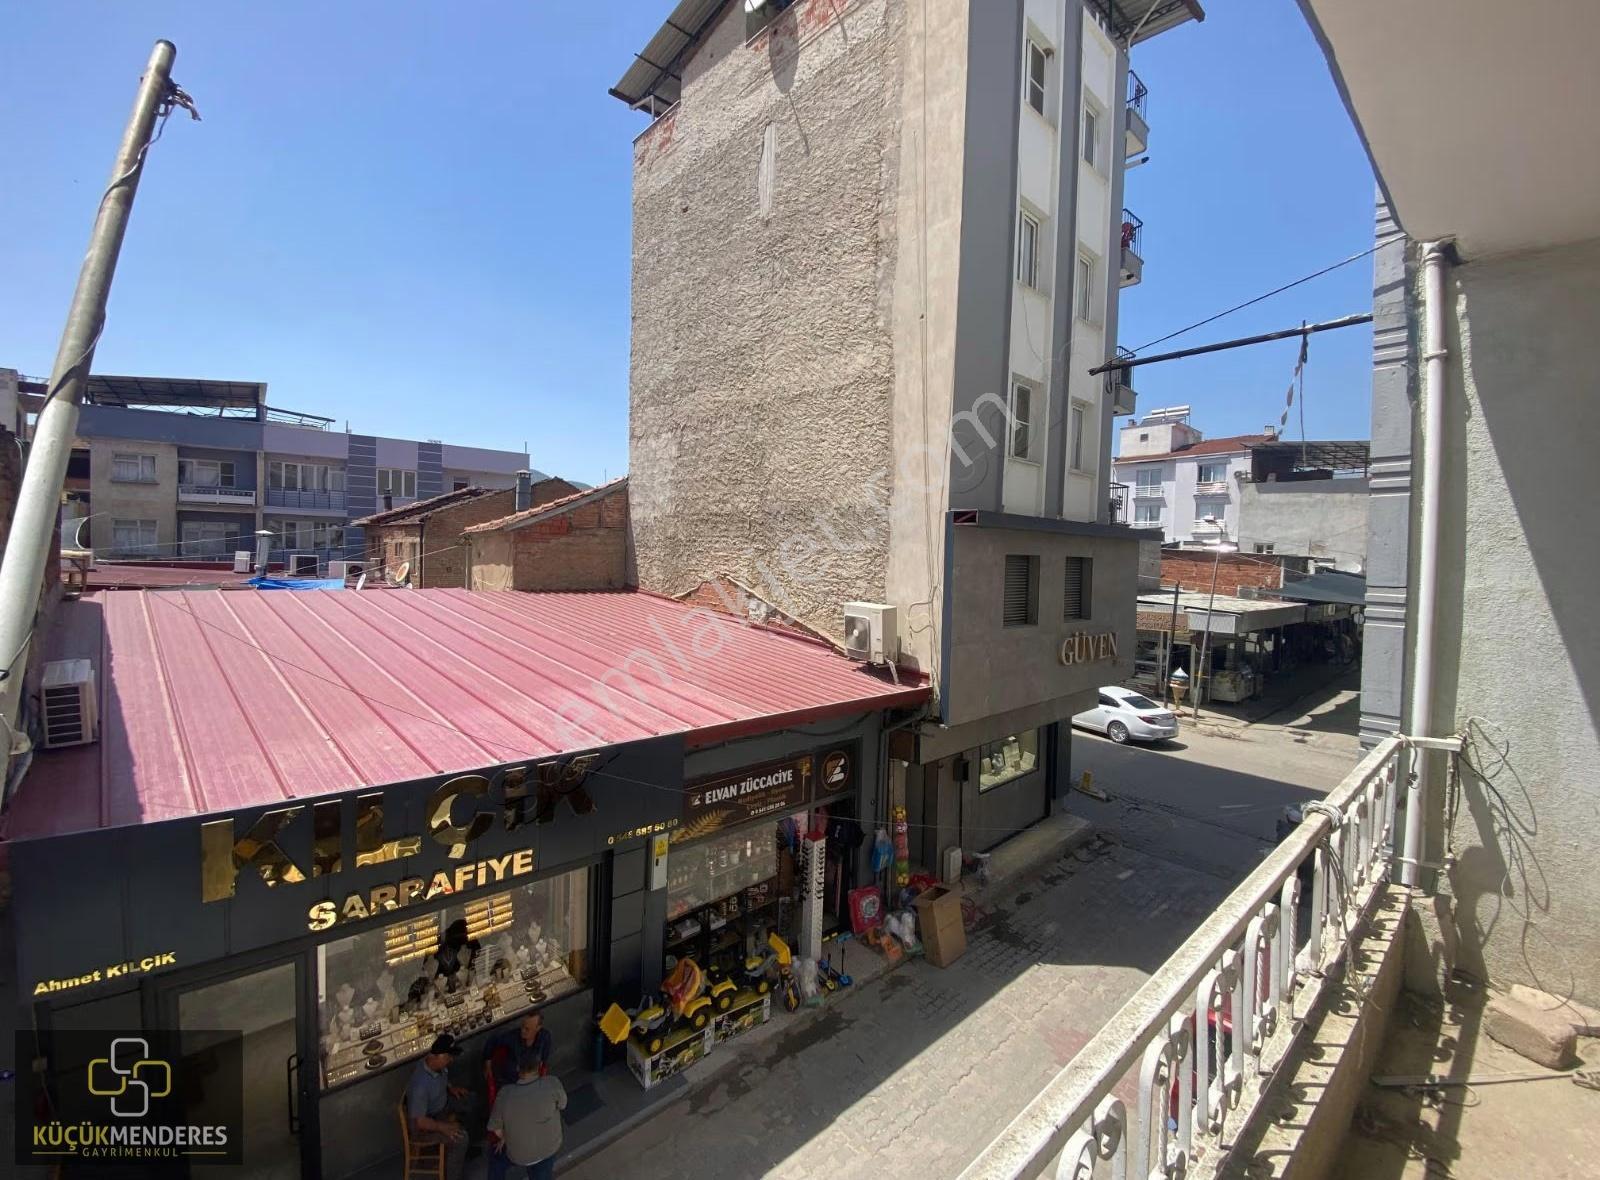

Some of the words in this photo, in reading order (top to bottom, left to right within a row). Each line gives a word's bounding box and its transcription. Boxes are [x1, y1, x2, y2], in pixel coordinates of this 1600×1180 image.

[1061, 631, 1120, 666] GÜVEN
[704, 783, 737, 805] ELVAN
[739, 768, 793, 794] ZÜCCACİYE
[307, 848, 535, 932] SARRAFİYE
[33, 968, 101, 996] Ahmet
